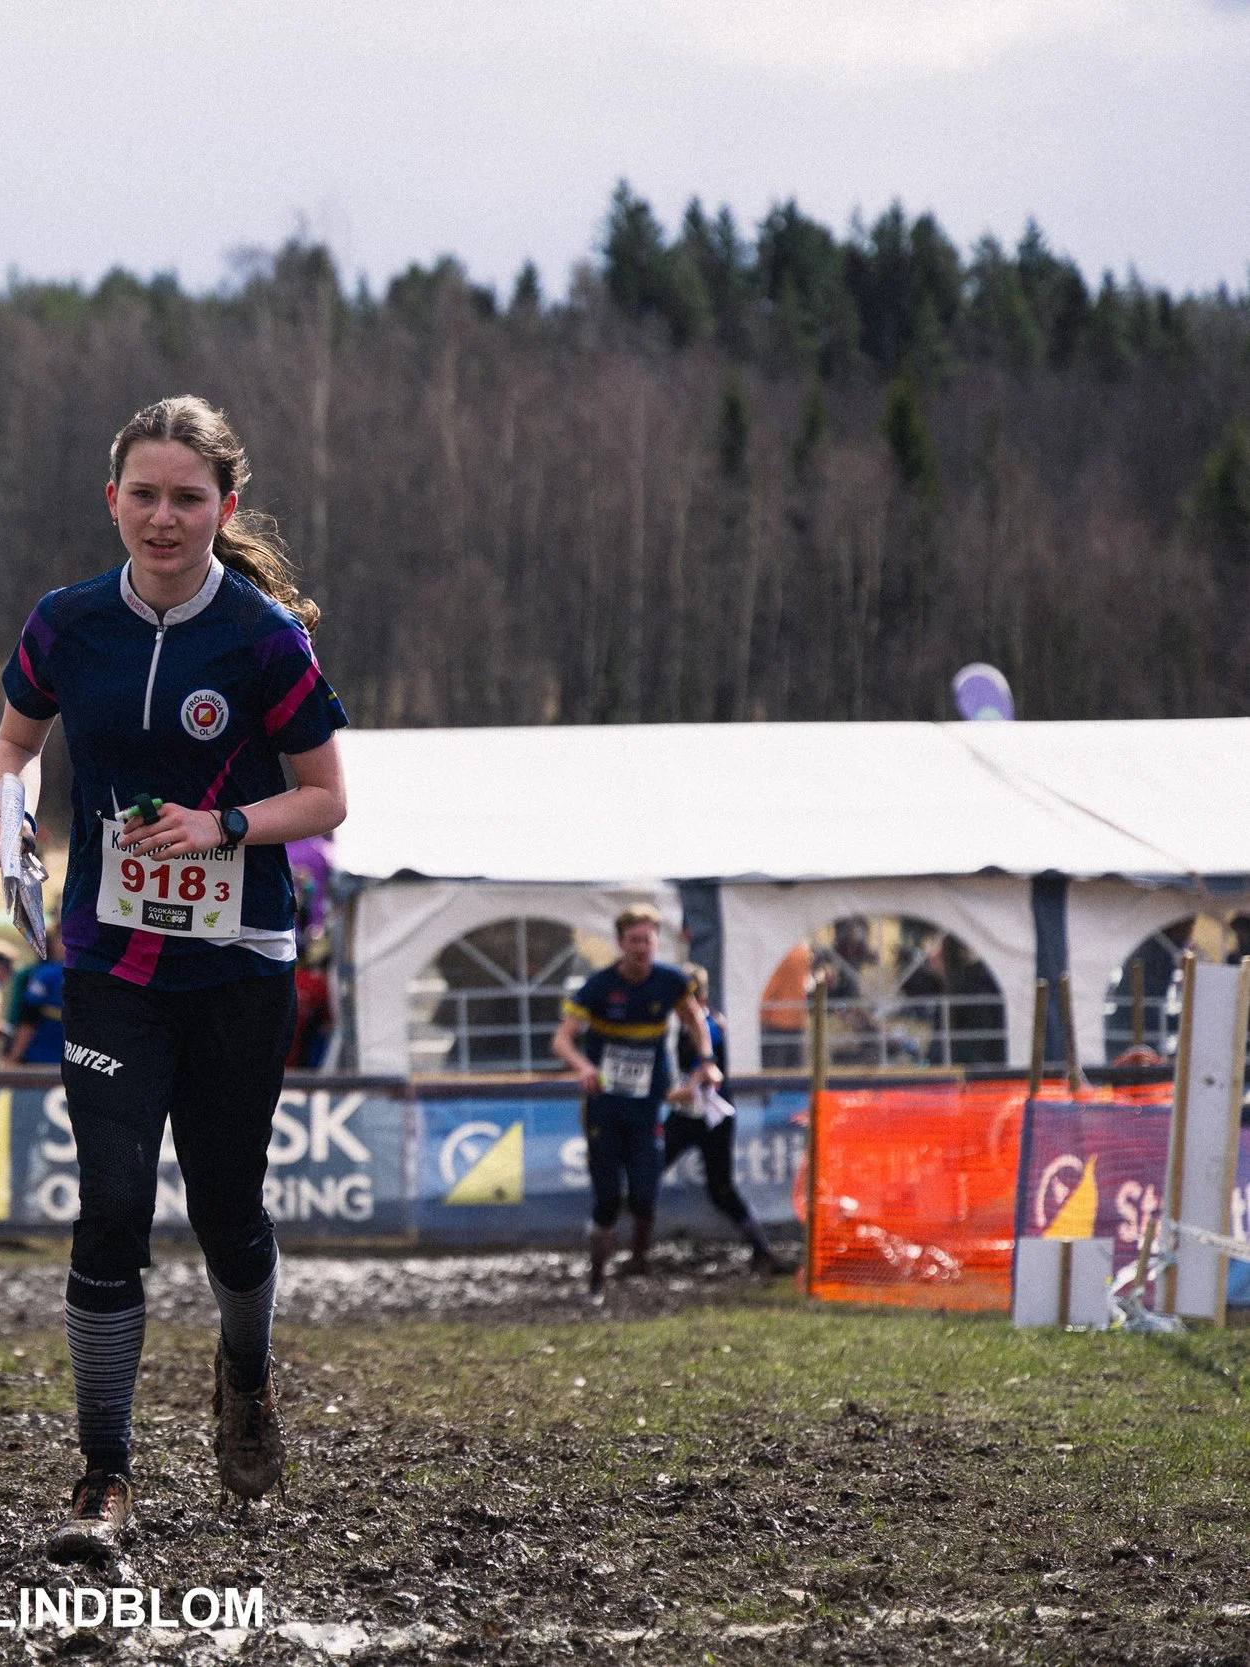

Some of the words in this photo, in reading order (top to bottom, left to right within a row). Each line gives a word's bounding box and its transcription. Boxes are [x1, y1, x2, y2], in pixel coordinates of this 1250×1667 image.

[186, 694, 224, 713] FRÖLUNDA
[199, 728, 211, 736] OL
[121, 858, 207, 902] 918
[214, 881, 230, 902] 3
